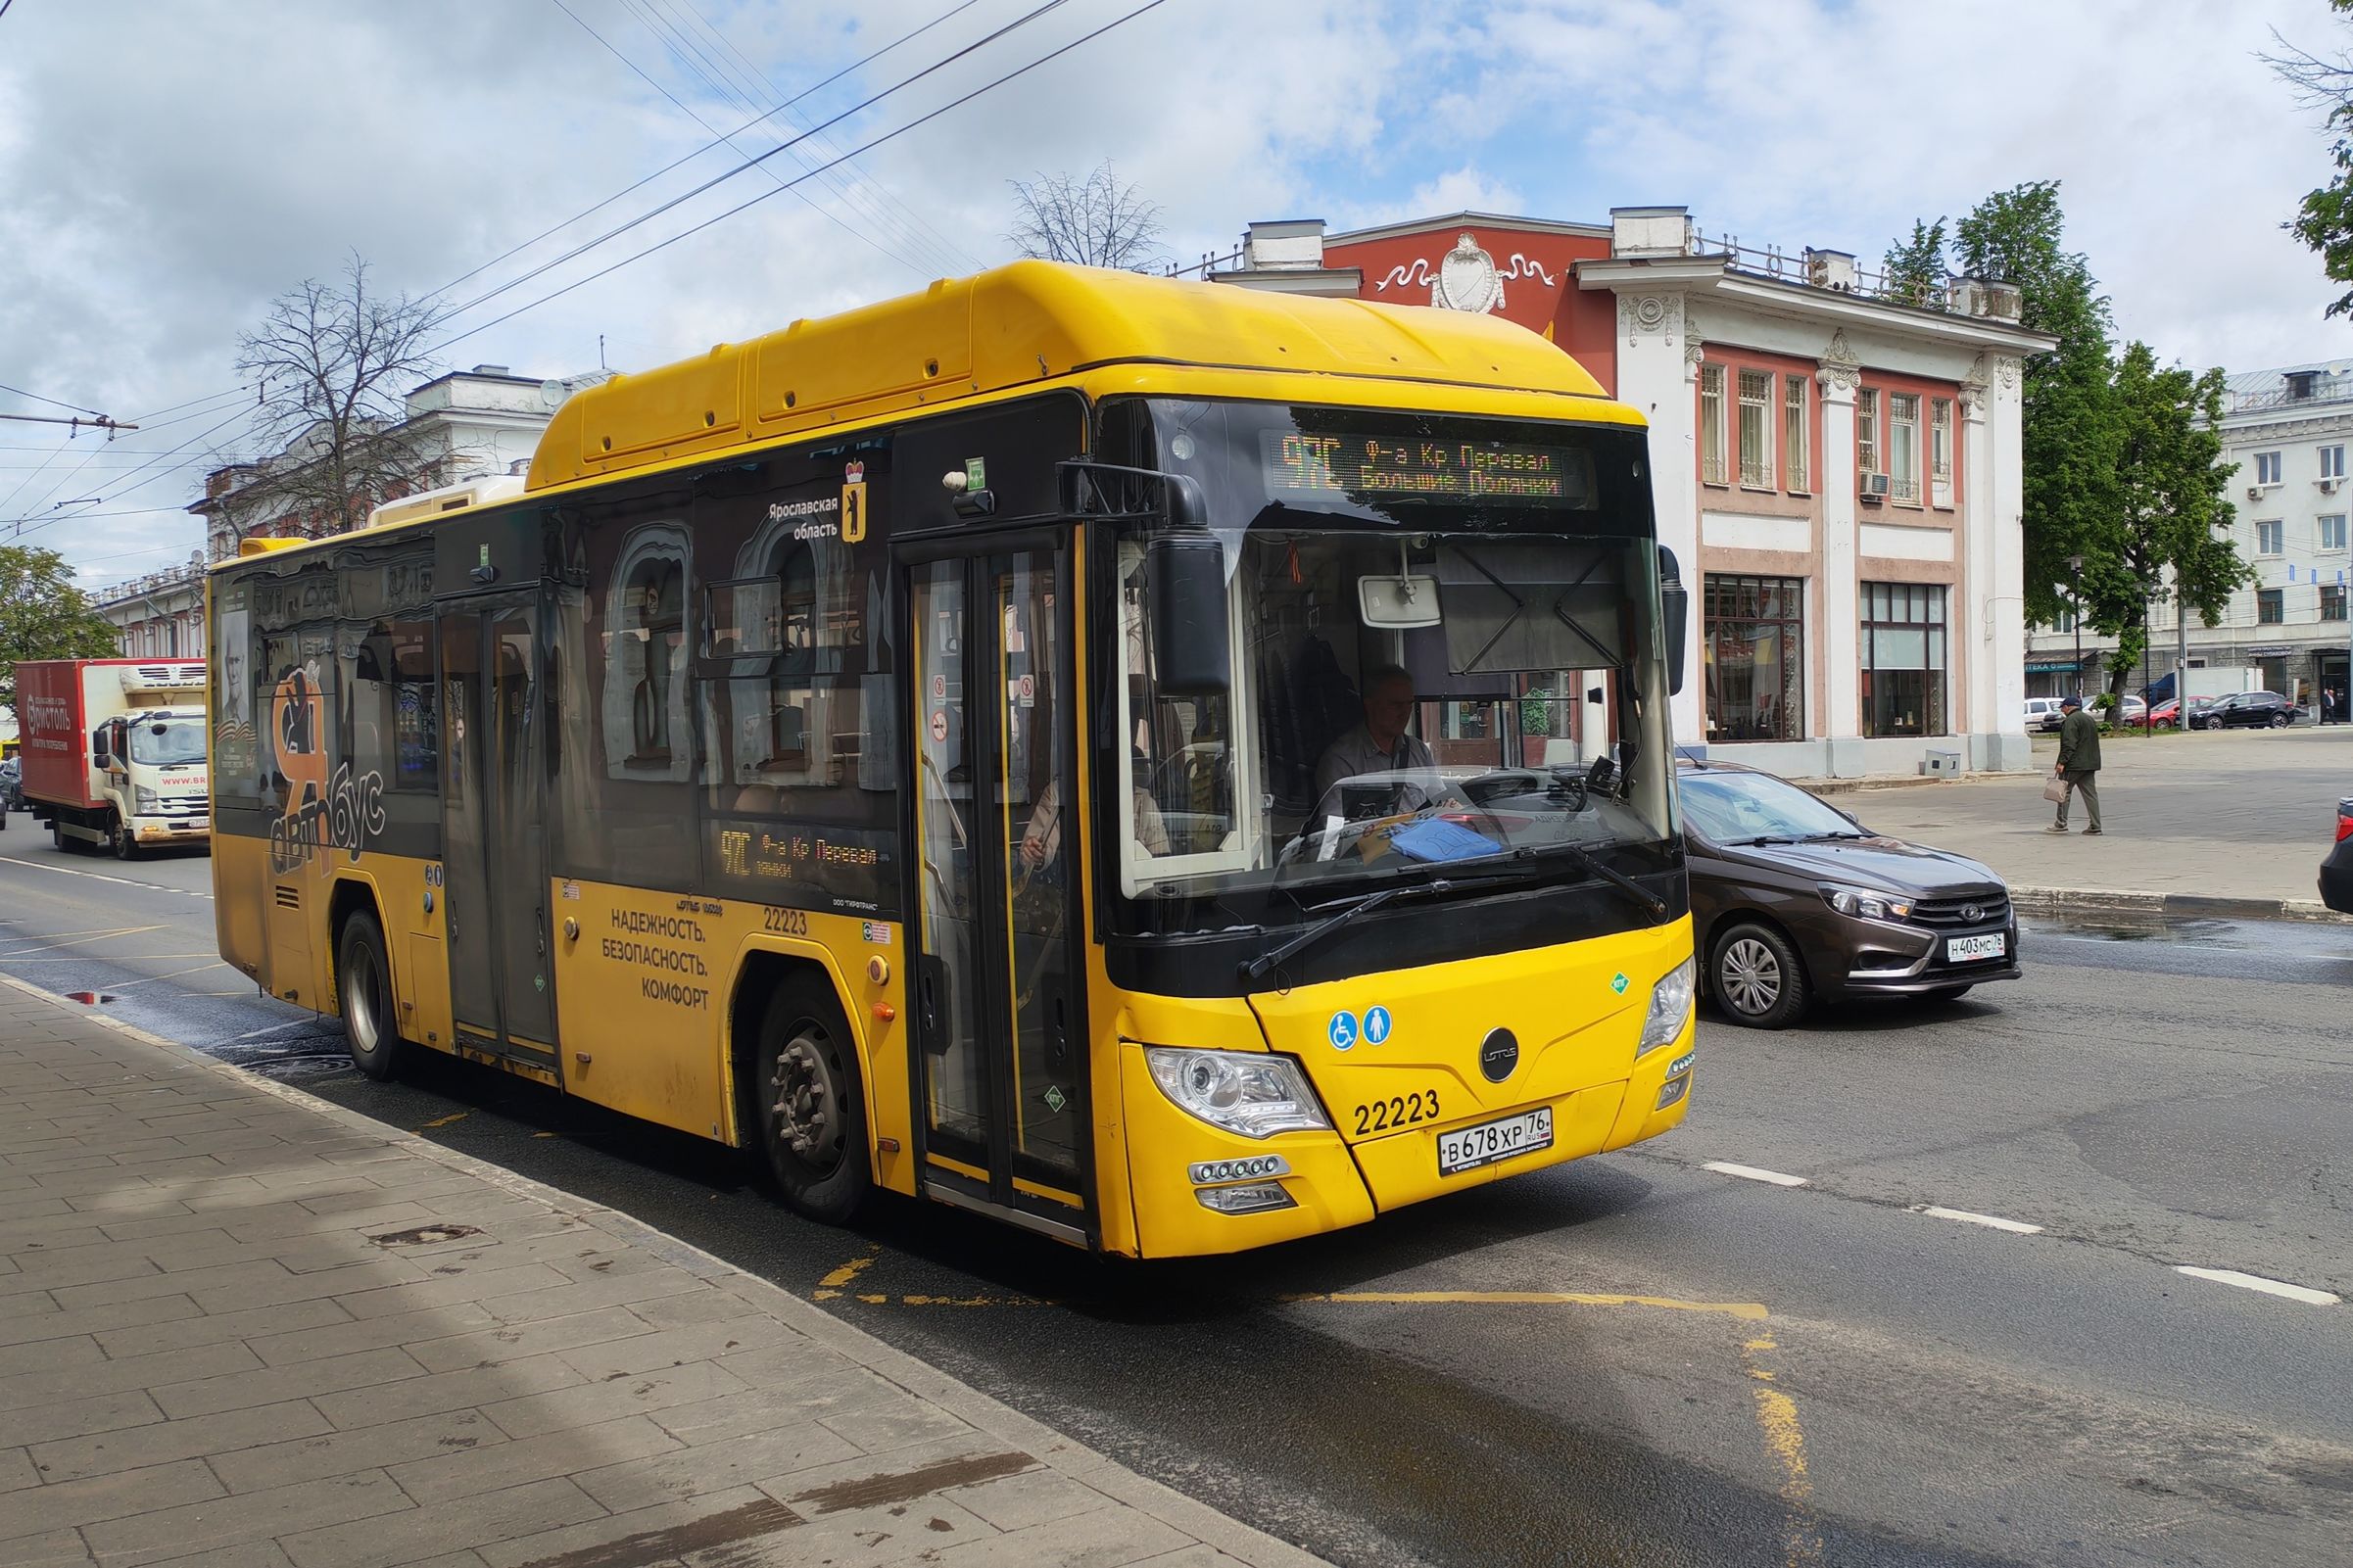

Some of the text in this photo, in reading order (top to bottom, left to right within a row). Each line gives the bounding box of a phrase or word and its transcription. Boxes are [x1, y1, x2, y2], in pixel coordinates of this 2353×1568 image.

[1421, 444, 1447, 469] Кр
[1462, 445, 1550, 470] Перевал
[1469, 470, 1559, 494] Полянки
[769, 498, 838, 522] Ярославская
[793, 523, 838, 541] область
[162, 777, 208, 785] WWW.BR
[792, 835, 809, 860] Кр
[815, 839, 877, 864] Перевал
[610, 908, 706, 943] НАДЕЖНОСТЬ.
[764, 907, 807, 936] 22223
[601, 938, 708, 977] БЕЗОПАСНОСТЬ.
[1951, 937, 1992, 956] Н403МС
[642, 977, 709, 1012] КОМФОРТ
[1354, 1089, 1440, 1136] 22223
[1448, 1113, 1545, 1164] В678ХР 76
